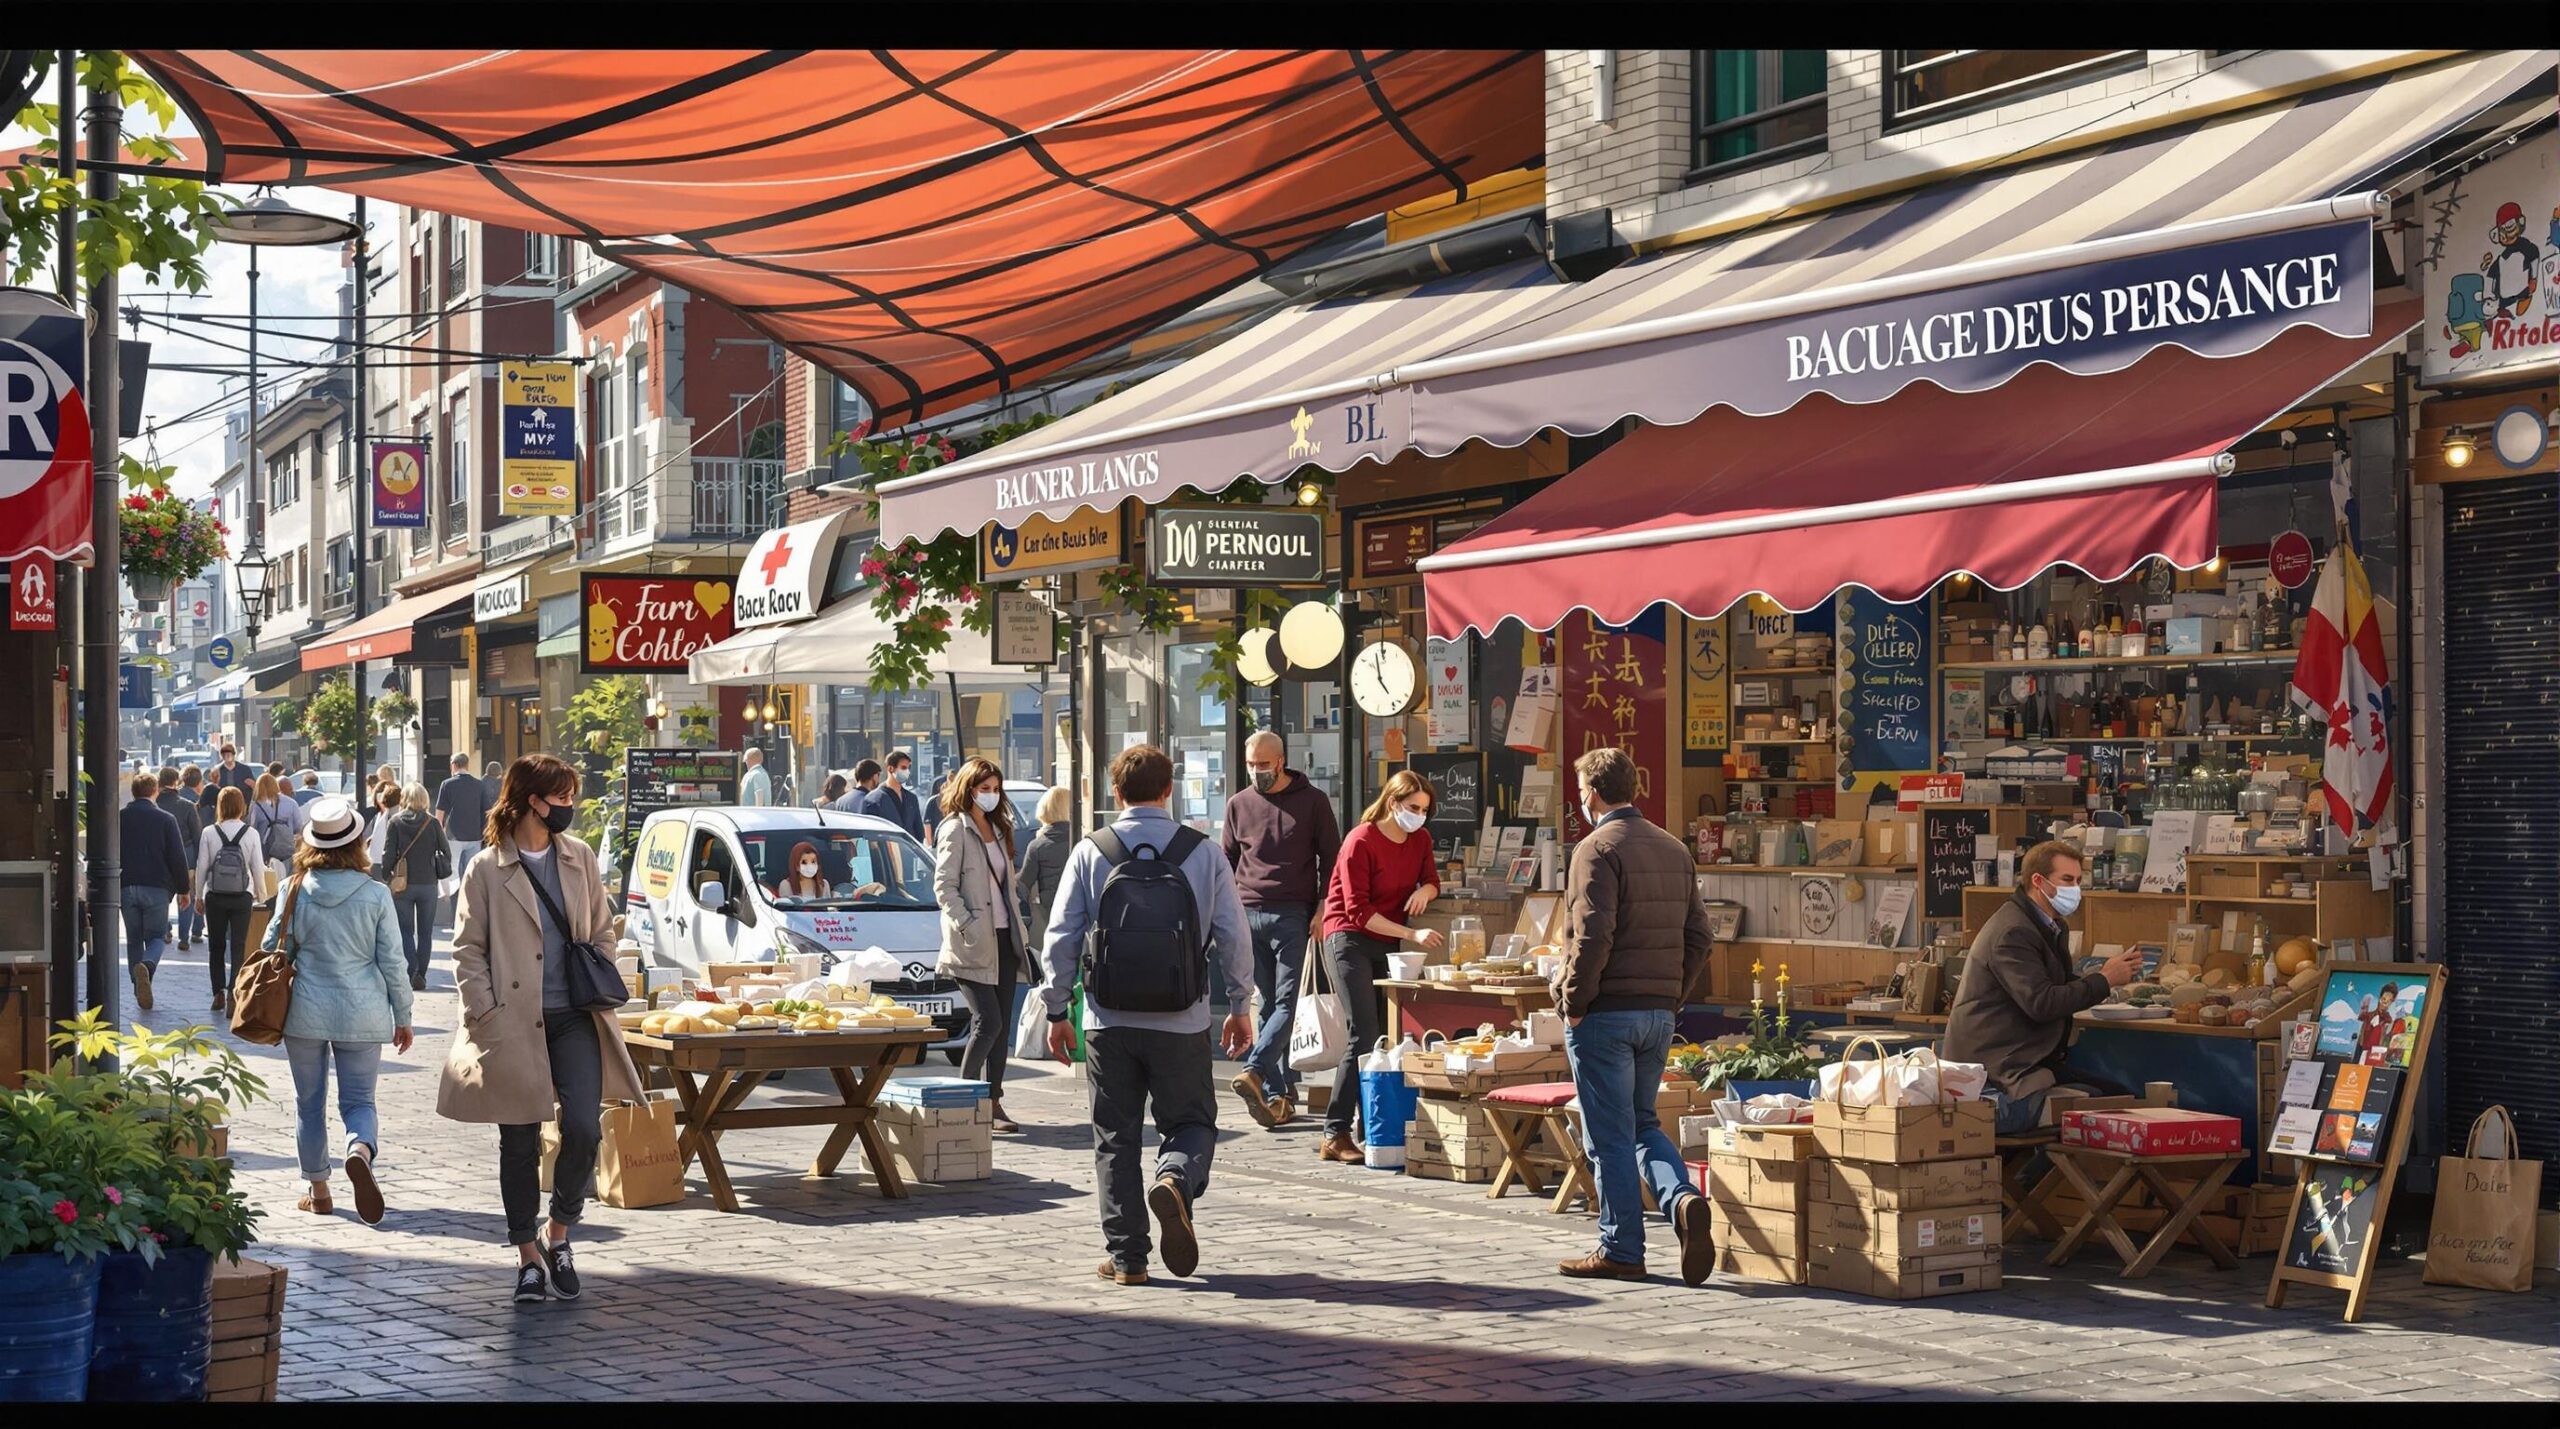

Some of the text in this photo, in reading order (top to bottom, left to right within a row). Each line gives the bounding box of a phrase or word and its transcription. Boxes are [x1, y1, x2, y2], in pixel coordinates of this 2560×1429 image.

[1786, 253, 2341, 382] BACUAGE DEUS PERSANGE
[996, 466, 1076, 510] BACNER
[1206, 533, 1311, 556] PERNOUL
